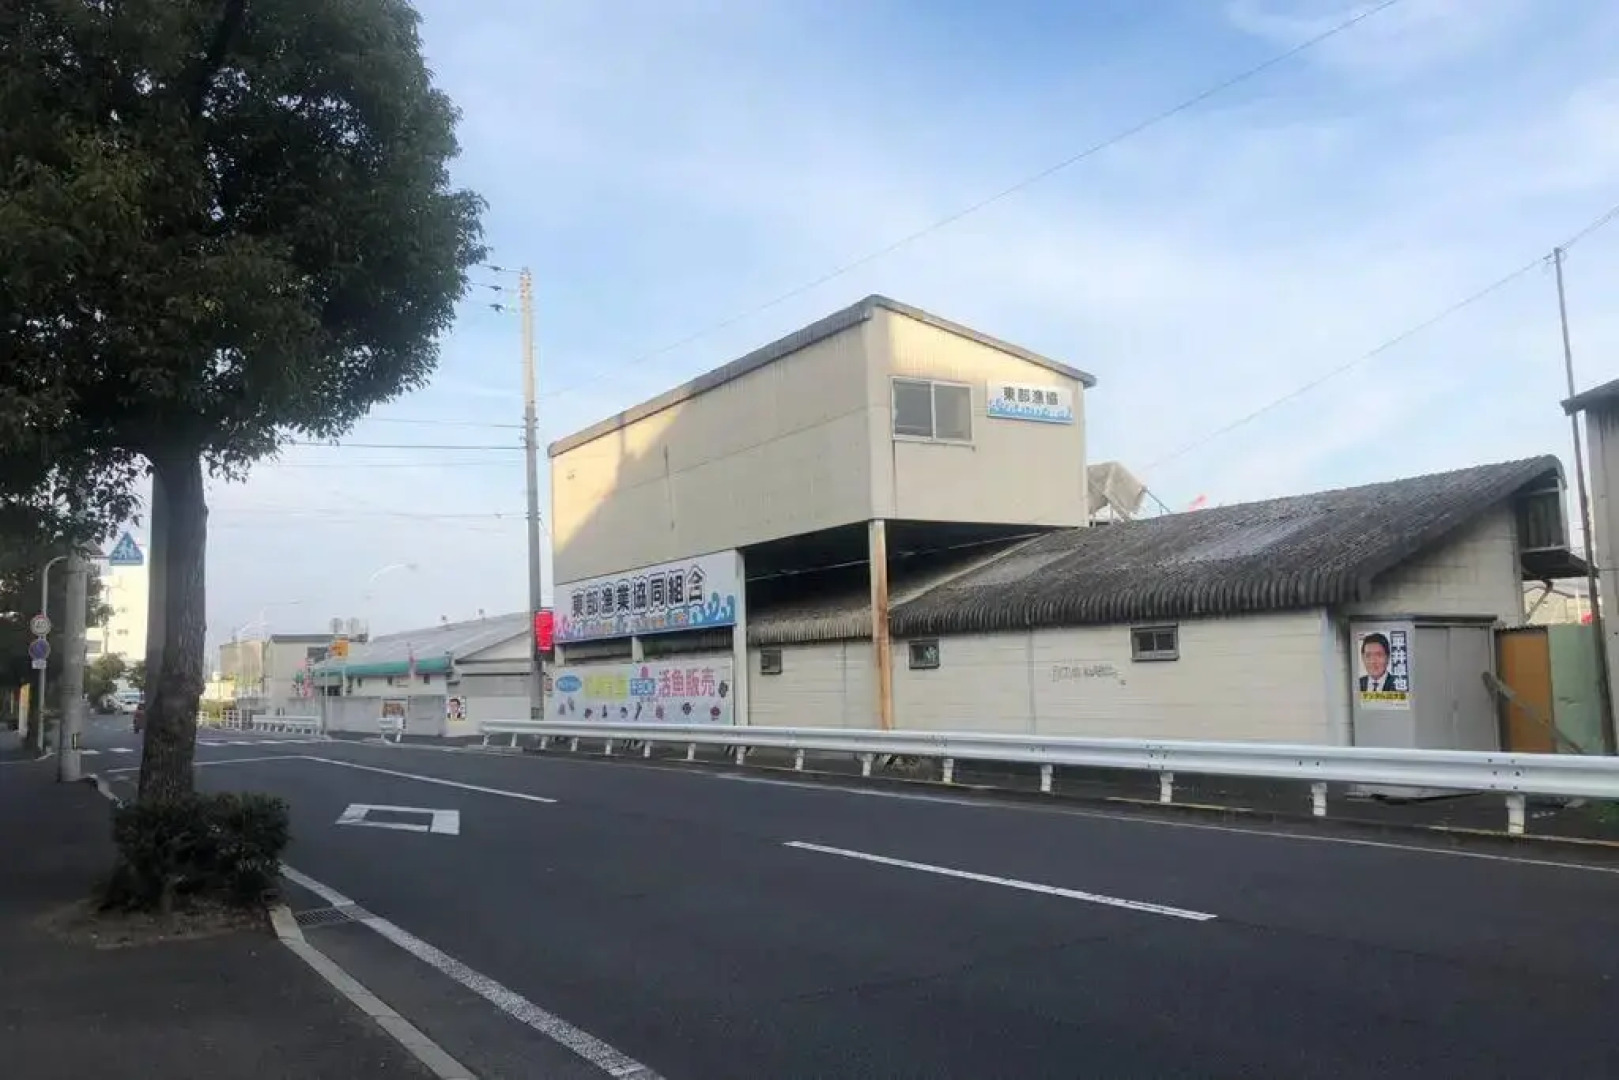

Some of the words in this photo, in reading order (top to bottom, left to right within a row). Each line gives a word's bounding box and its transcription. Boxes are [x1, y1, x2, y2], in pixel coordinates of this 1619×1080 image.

[571, 568, 704, 619] 東部漁業協同組合
[657, 667, 716, 698] 活魚販売
